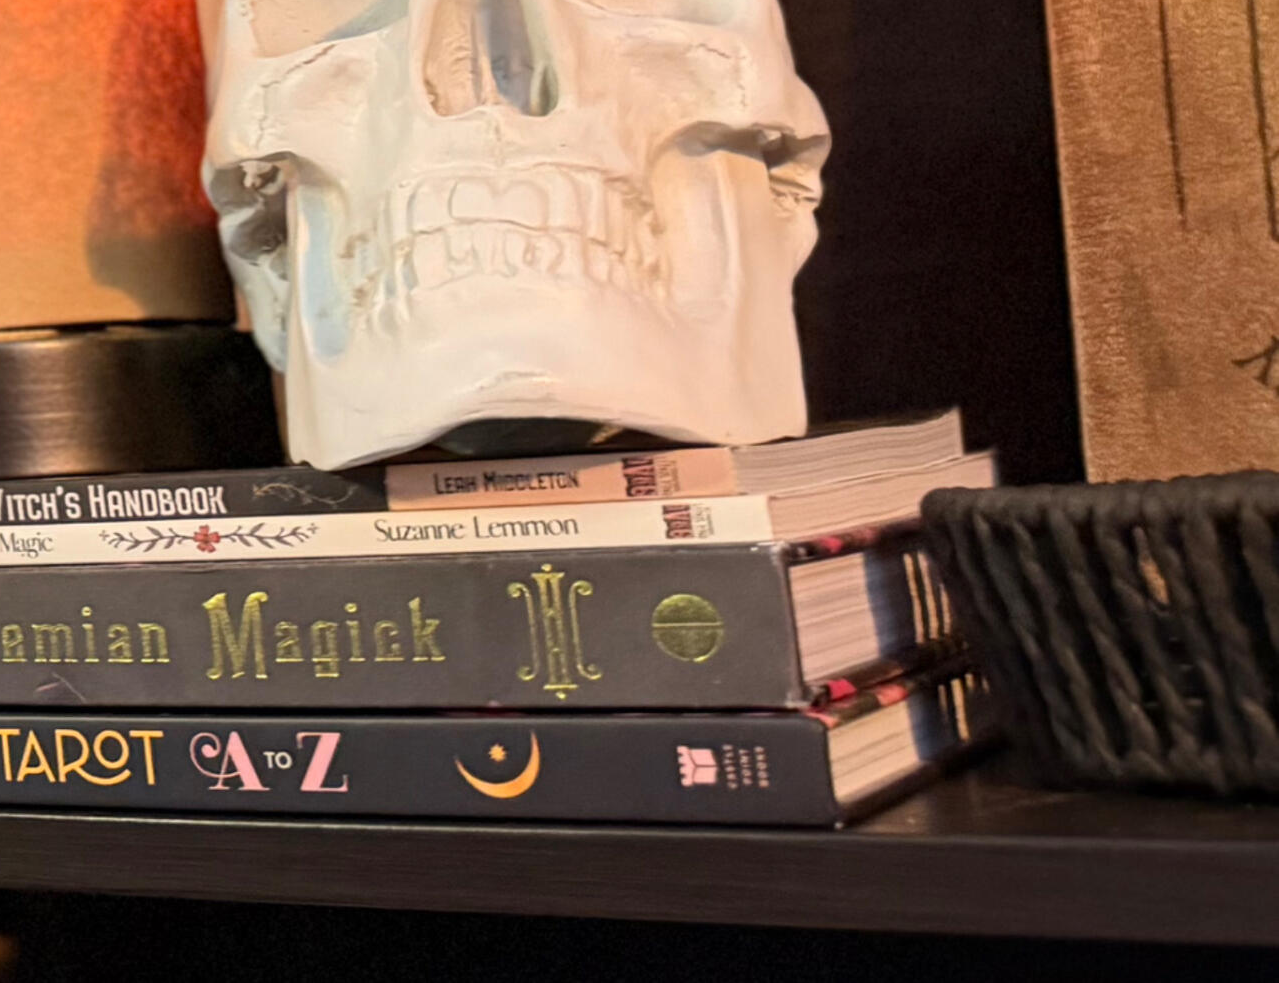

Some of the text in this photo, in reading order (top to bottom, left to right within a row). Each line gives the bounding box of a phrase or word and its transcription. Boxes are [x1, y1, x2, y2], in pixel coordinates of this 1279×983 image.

[433, 469, 581, 495] LEAH MIDDLETON
[87, 484, 228, 518] HANDBOOK
[373, 515, 580, 543] Suzanne Lemmon
[202, 591, 446, 679] Magick
[190, 731, 271, 791] A
[263, 750, 292, 770] TO
[296, 732, 349, 792] Z
